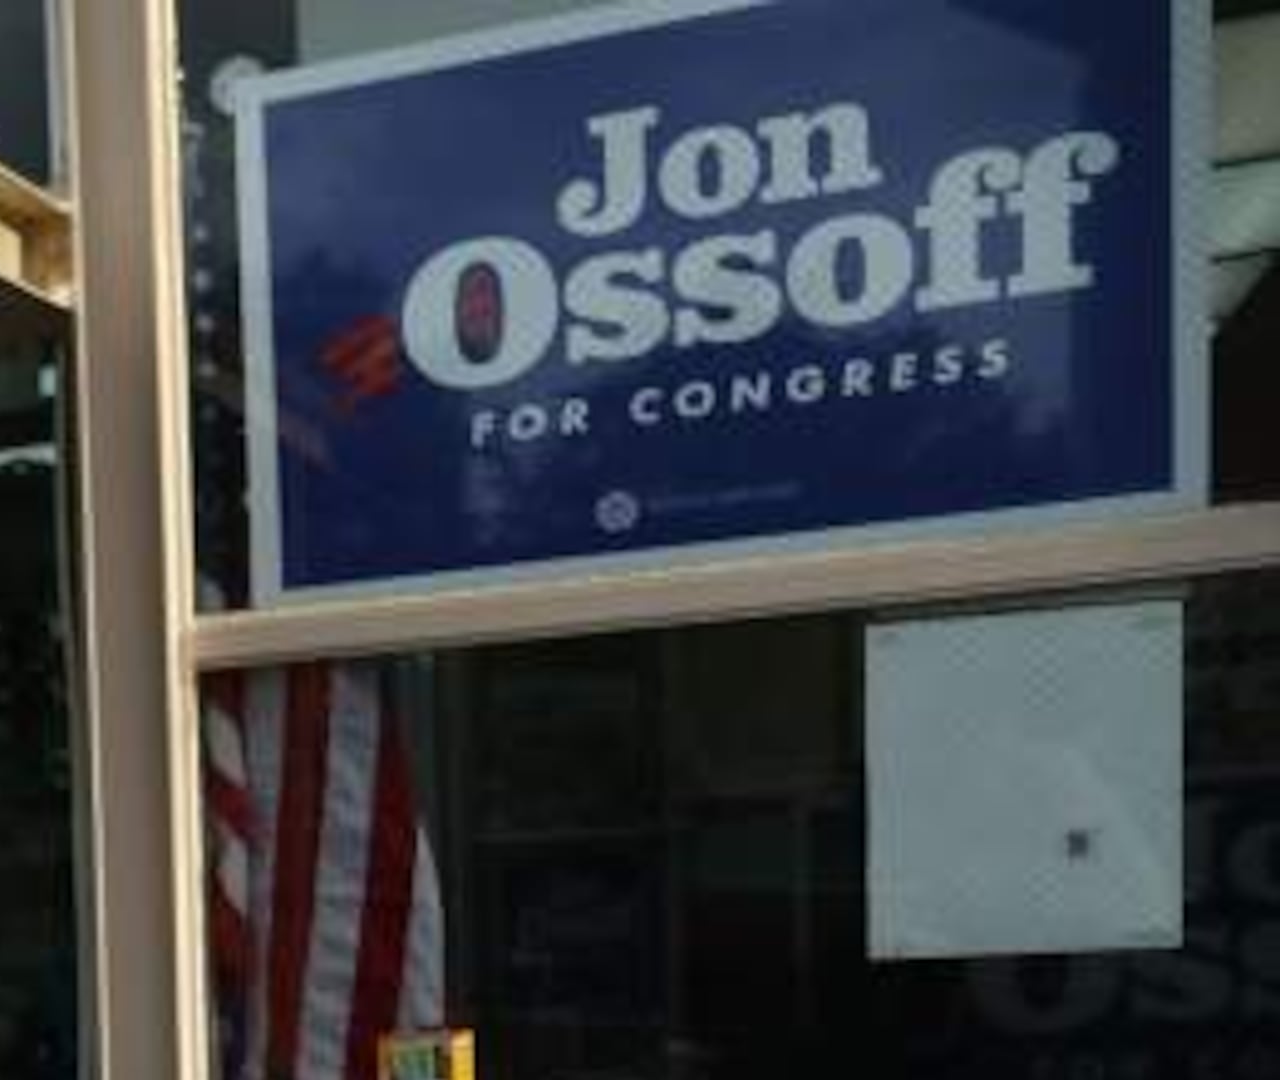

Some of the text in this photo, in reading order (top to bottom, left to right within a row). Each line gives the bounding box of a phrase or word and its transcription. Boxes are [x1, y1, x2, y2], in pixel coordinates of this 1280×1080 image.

[554, 103, 884, 238] Jon
[401, 130, 1120, 389] Ossoff
[468, 338, 1011, 448] FOR CONGRESS
